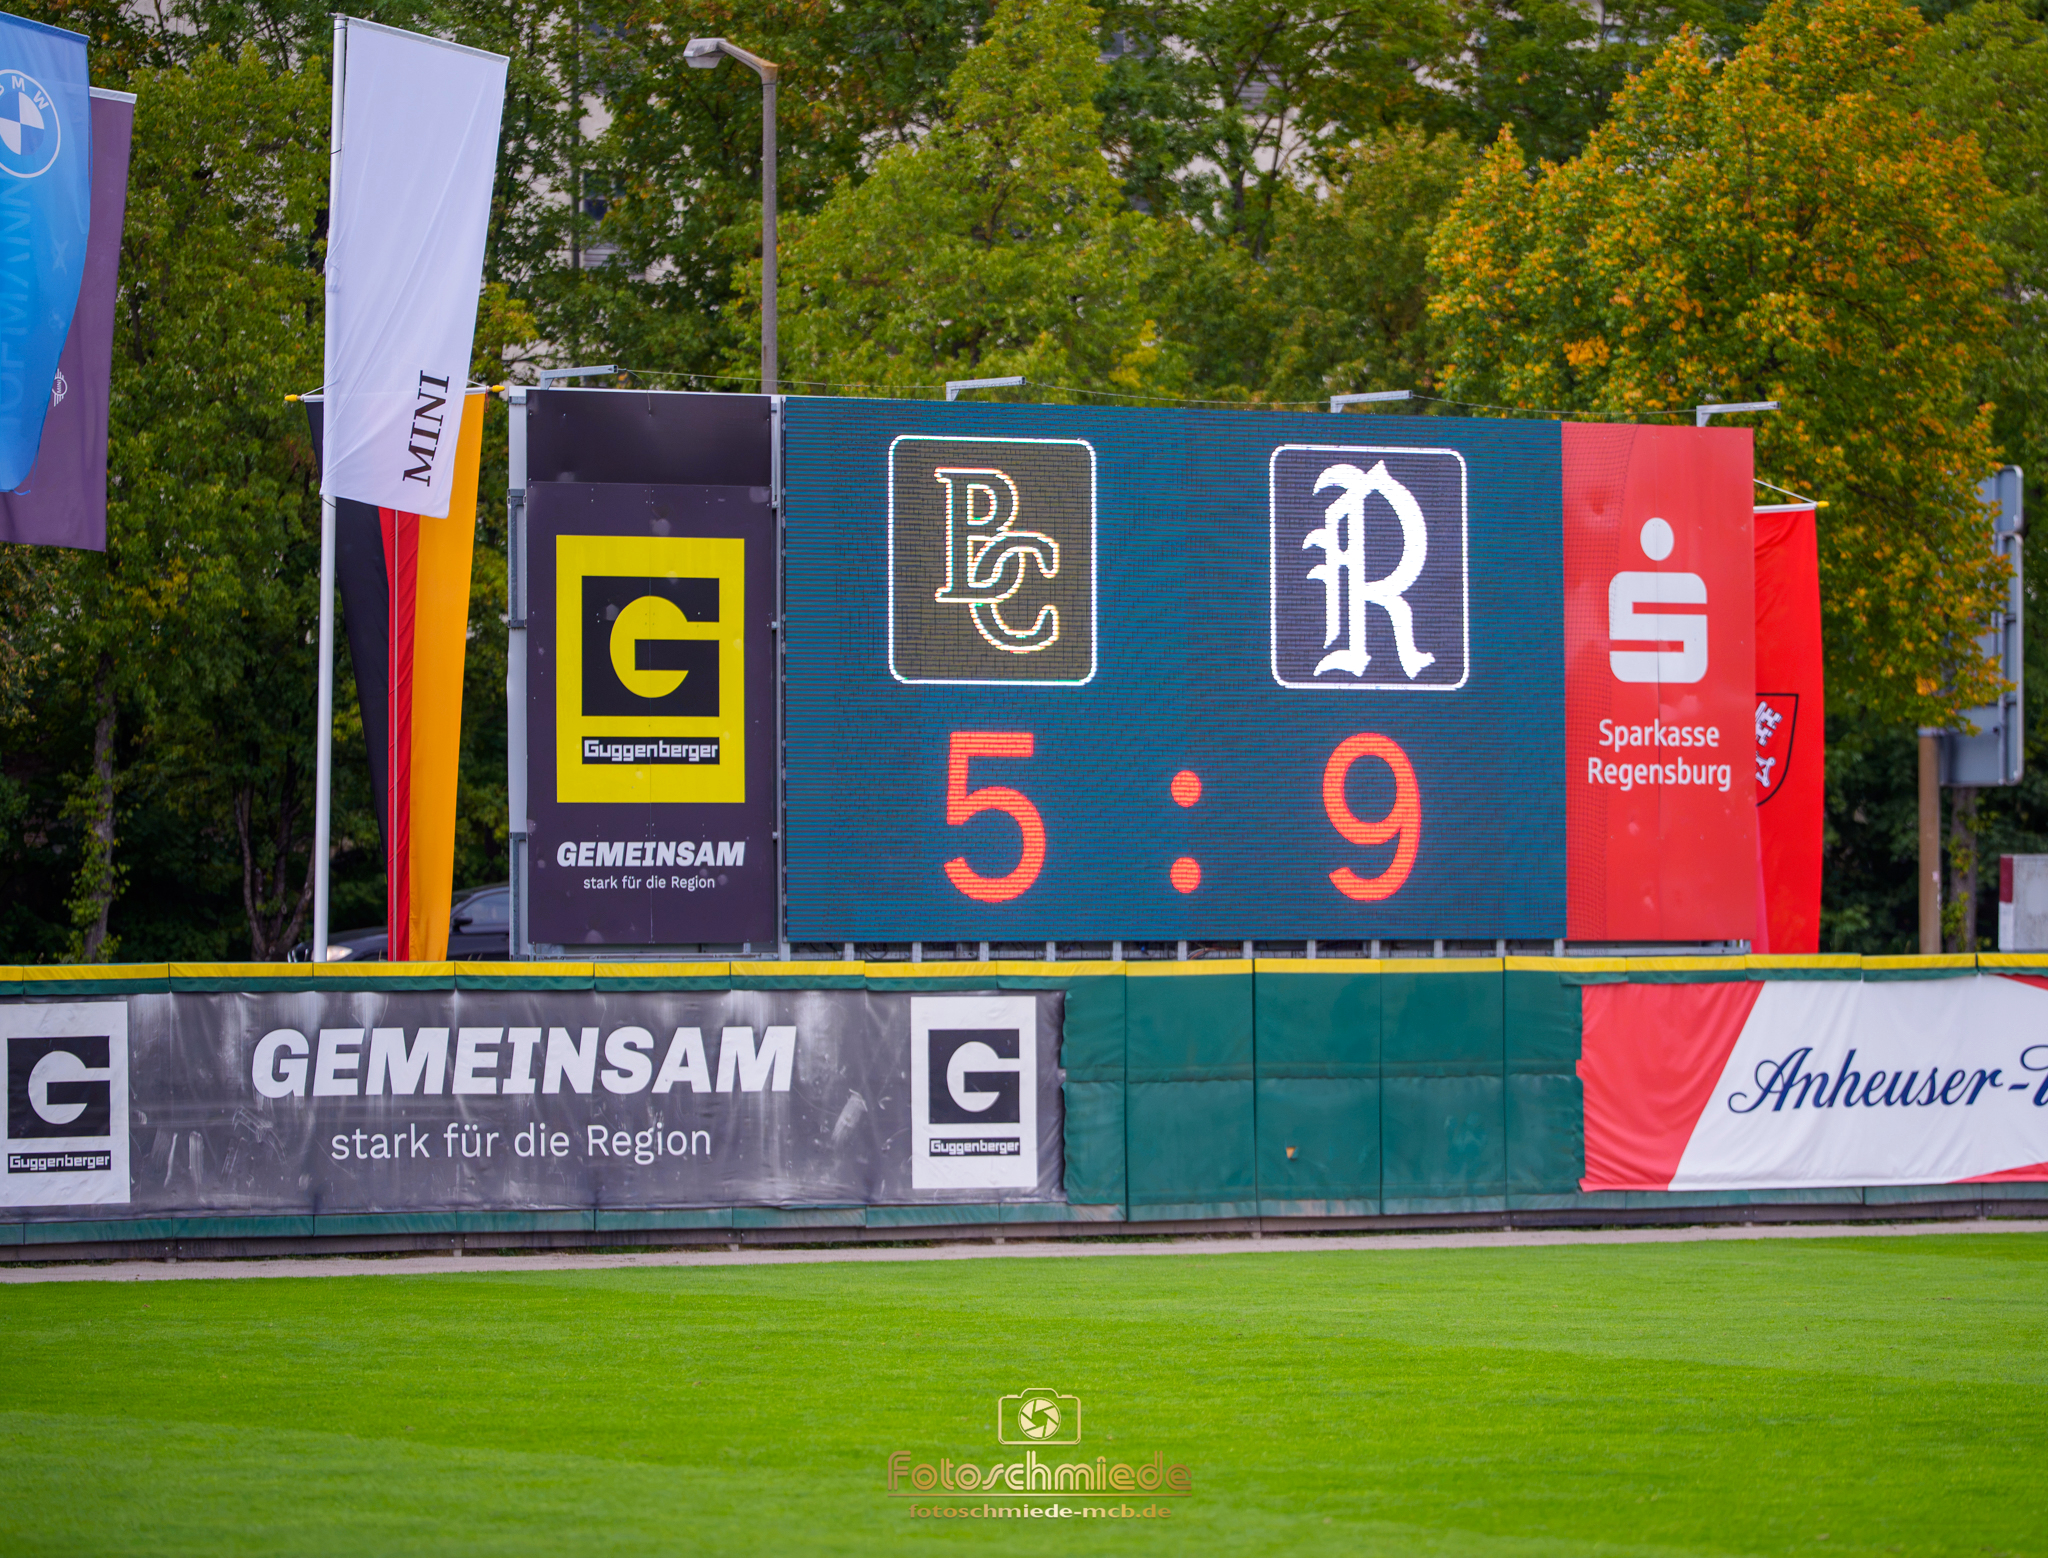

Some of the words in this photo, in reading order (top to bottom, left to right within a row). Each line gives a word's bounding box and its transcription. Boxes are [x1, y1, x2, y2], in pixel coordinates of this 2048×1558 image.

[402, 370, 449, 487] MINI
[1302, 460, 1436, 680] R
[609, 595, 719, 698] G
[583, 739, 719, 762] Guggenberger
[1598, 718, 1720, 753] Sparkasse
[1587, 756, 1732, 792] Regensburg
[944, 731, 1046, 903] 5
[1170, 769, 1202, 894] :
[1322, 732, 1422, 902] 9
[556, 841, 746, 867] GEMEINSAM
[583, 875, 618, 889] stark
[622, 875, 642, 889] für
[646, 875, 666, 889] die
[671, 875, 716, 892] Region
[251, 1025, 797, 1098] GEMEINSAM
[946, 1041, 1020, 1112] G
[28, 1050, 110, 1124] G
[9, 1154, 110, 1171] Guggenberger
[331, 1122, 430, 1160] stark
[443, 1121, 499, 1158] für
[514, 1122, 570, 1158] die
[587, 1122, 712, 1165] Region
[931, 1139, 1020, 1155] Guggenberger
